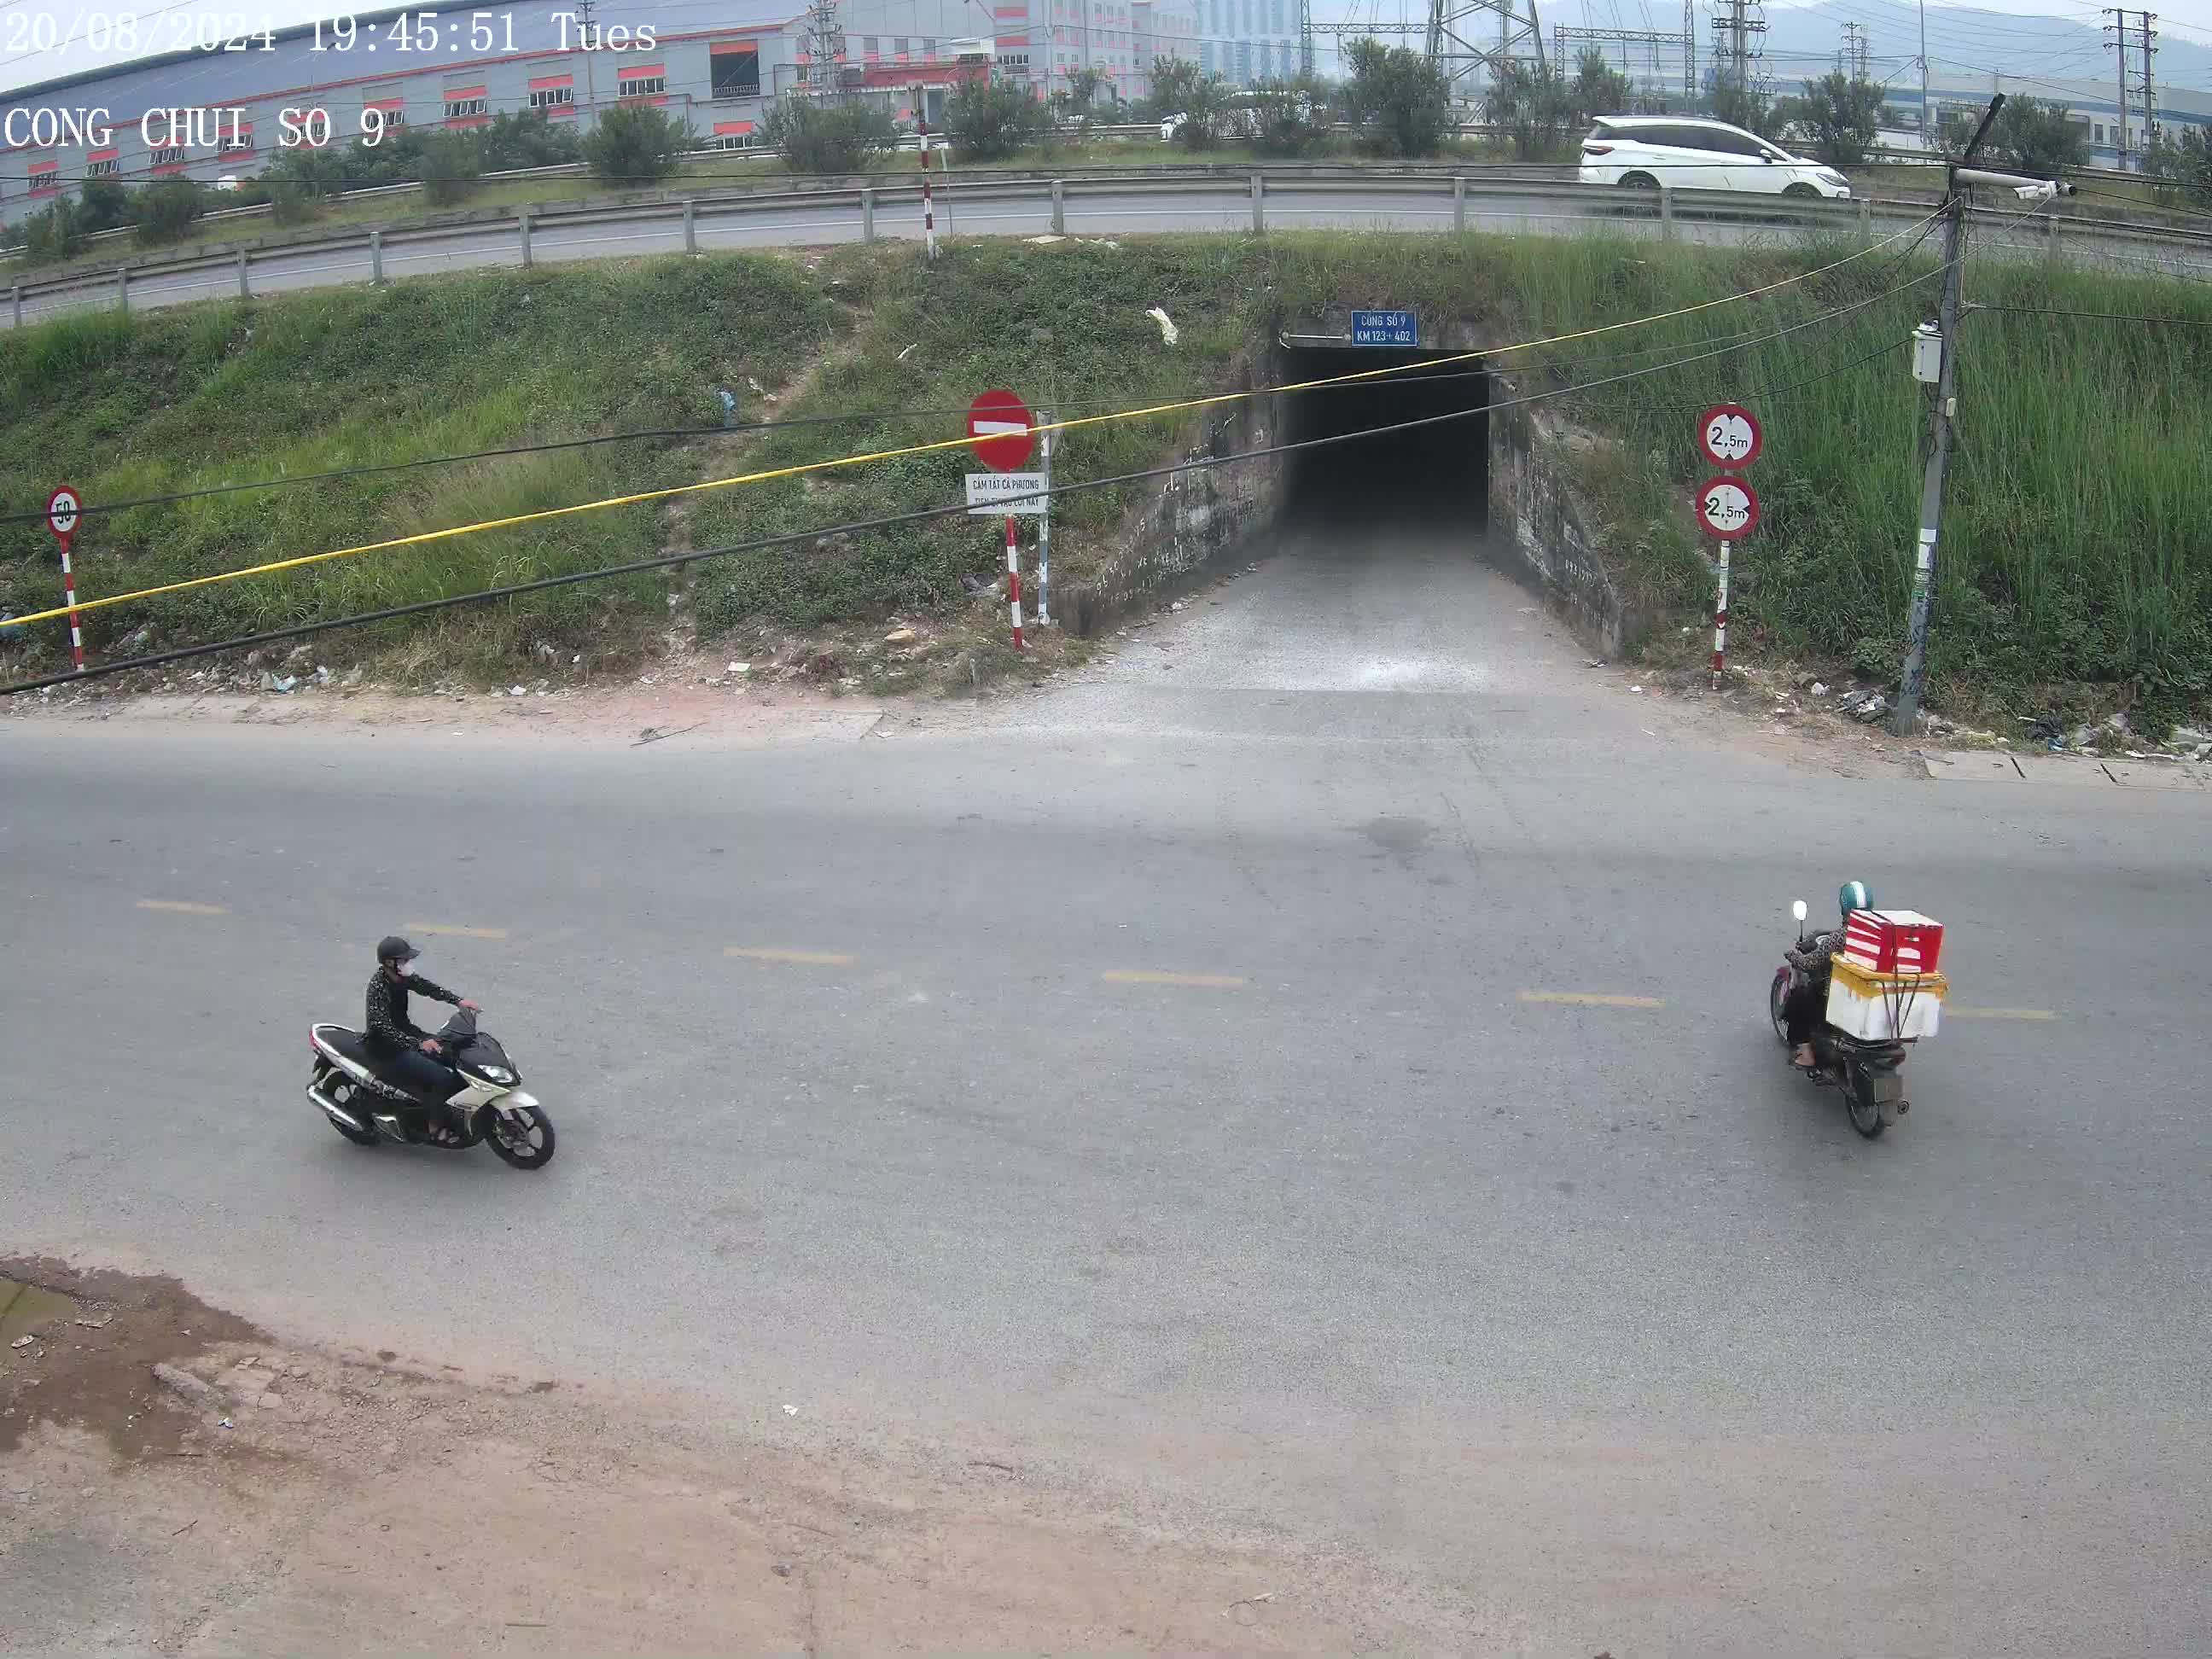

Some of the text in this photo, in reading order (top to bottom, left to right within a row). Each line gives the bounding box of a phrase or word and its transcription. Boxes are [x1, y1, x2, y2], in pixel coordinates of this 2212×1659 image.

[1400, 315, 1406, 326] 9
[1357, 330, 1371, 341] KM
[1711, 426, 1749, 448] 2,5m
[55, 500, 72, 524] 50
[1708, 497, 1745, 519] 2,5m
